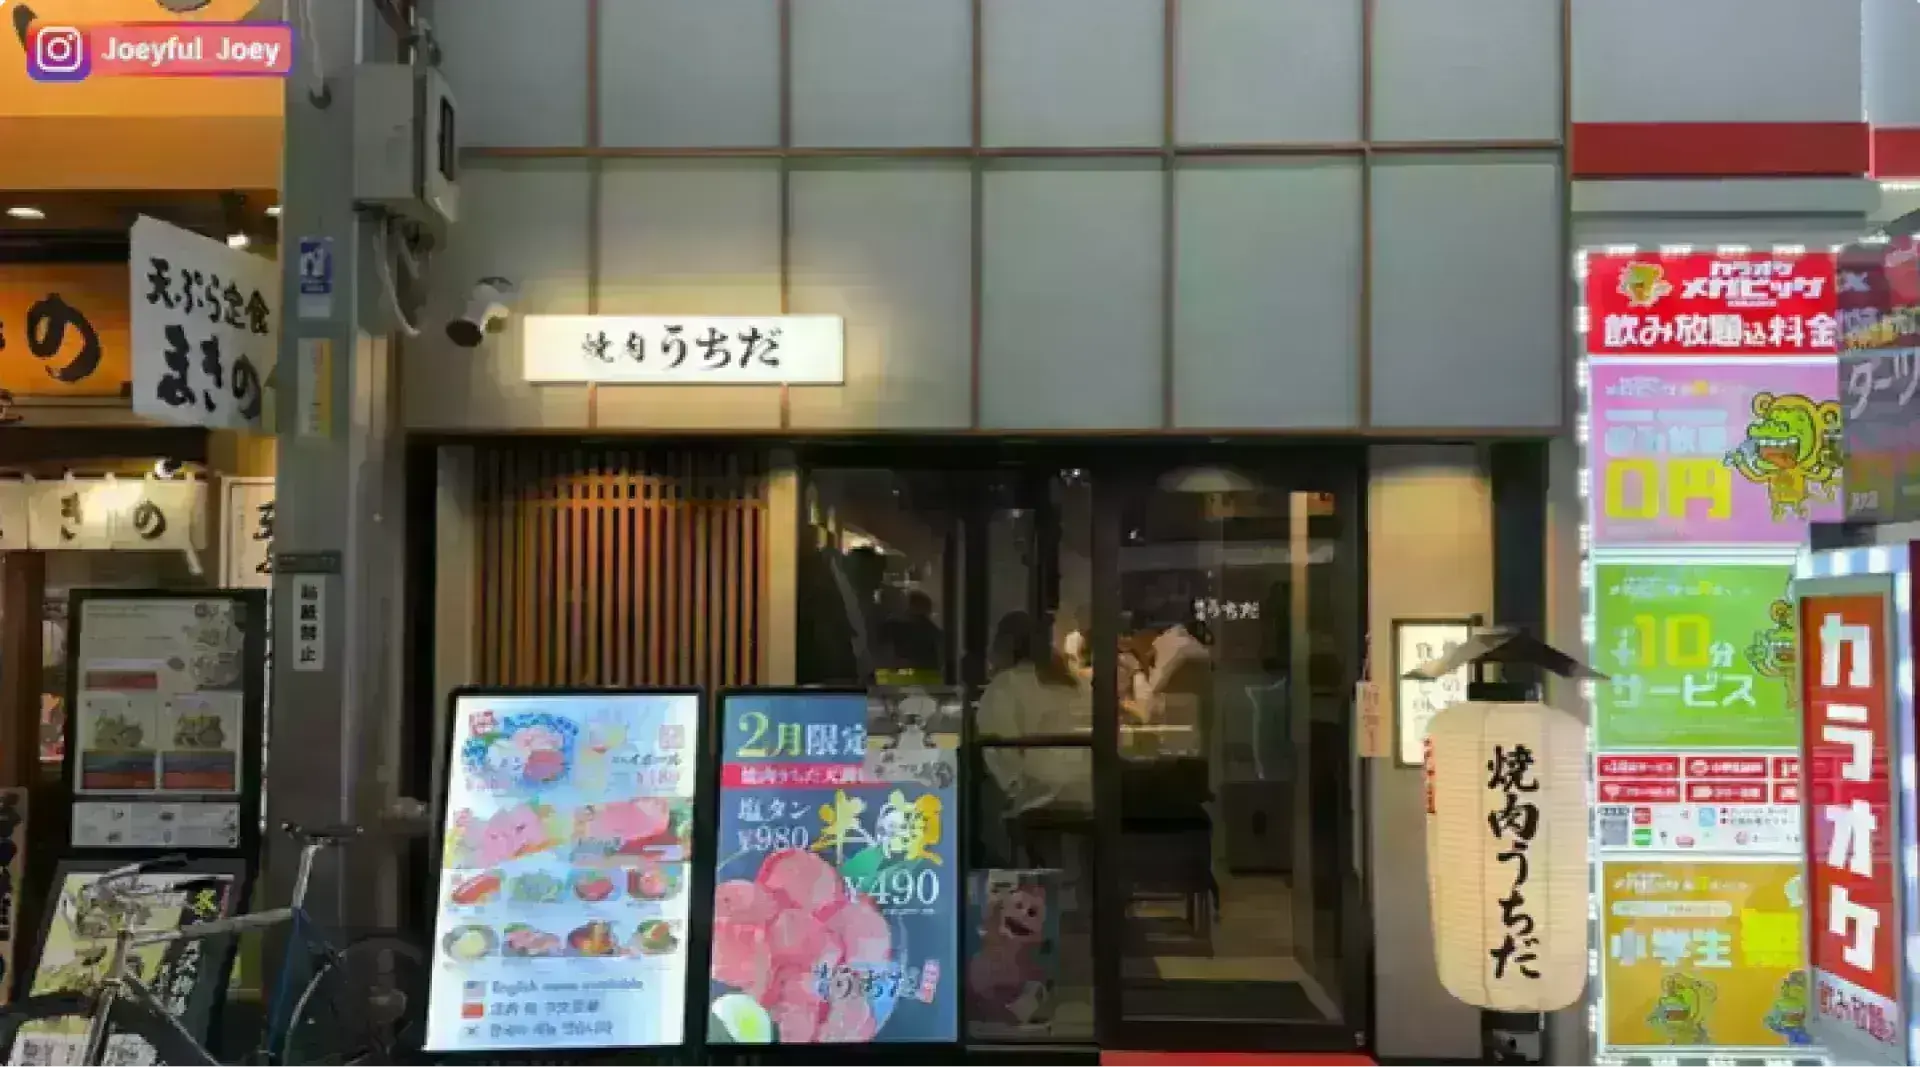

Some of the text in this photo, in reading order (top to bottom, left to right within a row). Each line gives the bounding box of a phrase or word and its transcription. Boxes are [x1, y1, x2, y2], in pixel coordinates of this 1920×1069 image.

[145, 255, 271, 337] 天ぷら定食
[581, 324, 785, 371] 焼肉うちだ
[156, 323, 263, 421] まきの
[1610, 671, 1757, 710] サービス
[735, 710, 867, 758] 2月限定
[737, 796, 812, 822] 塩タン
[1819, 612, 1882, 974] カラオケ
[1486, 742, 1542, 980] 焼肉うちだ
[844, 867, 940, 907] ¥490
[1610, 926, 1733, 968] 小学生
